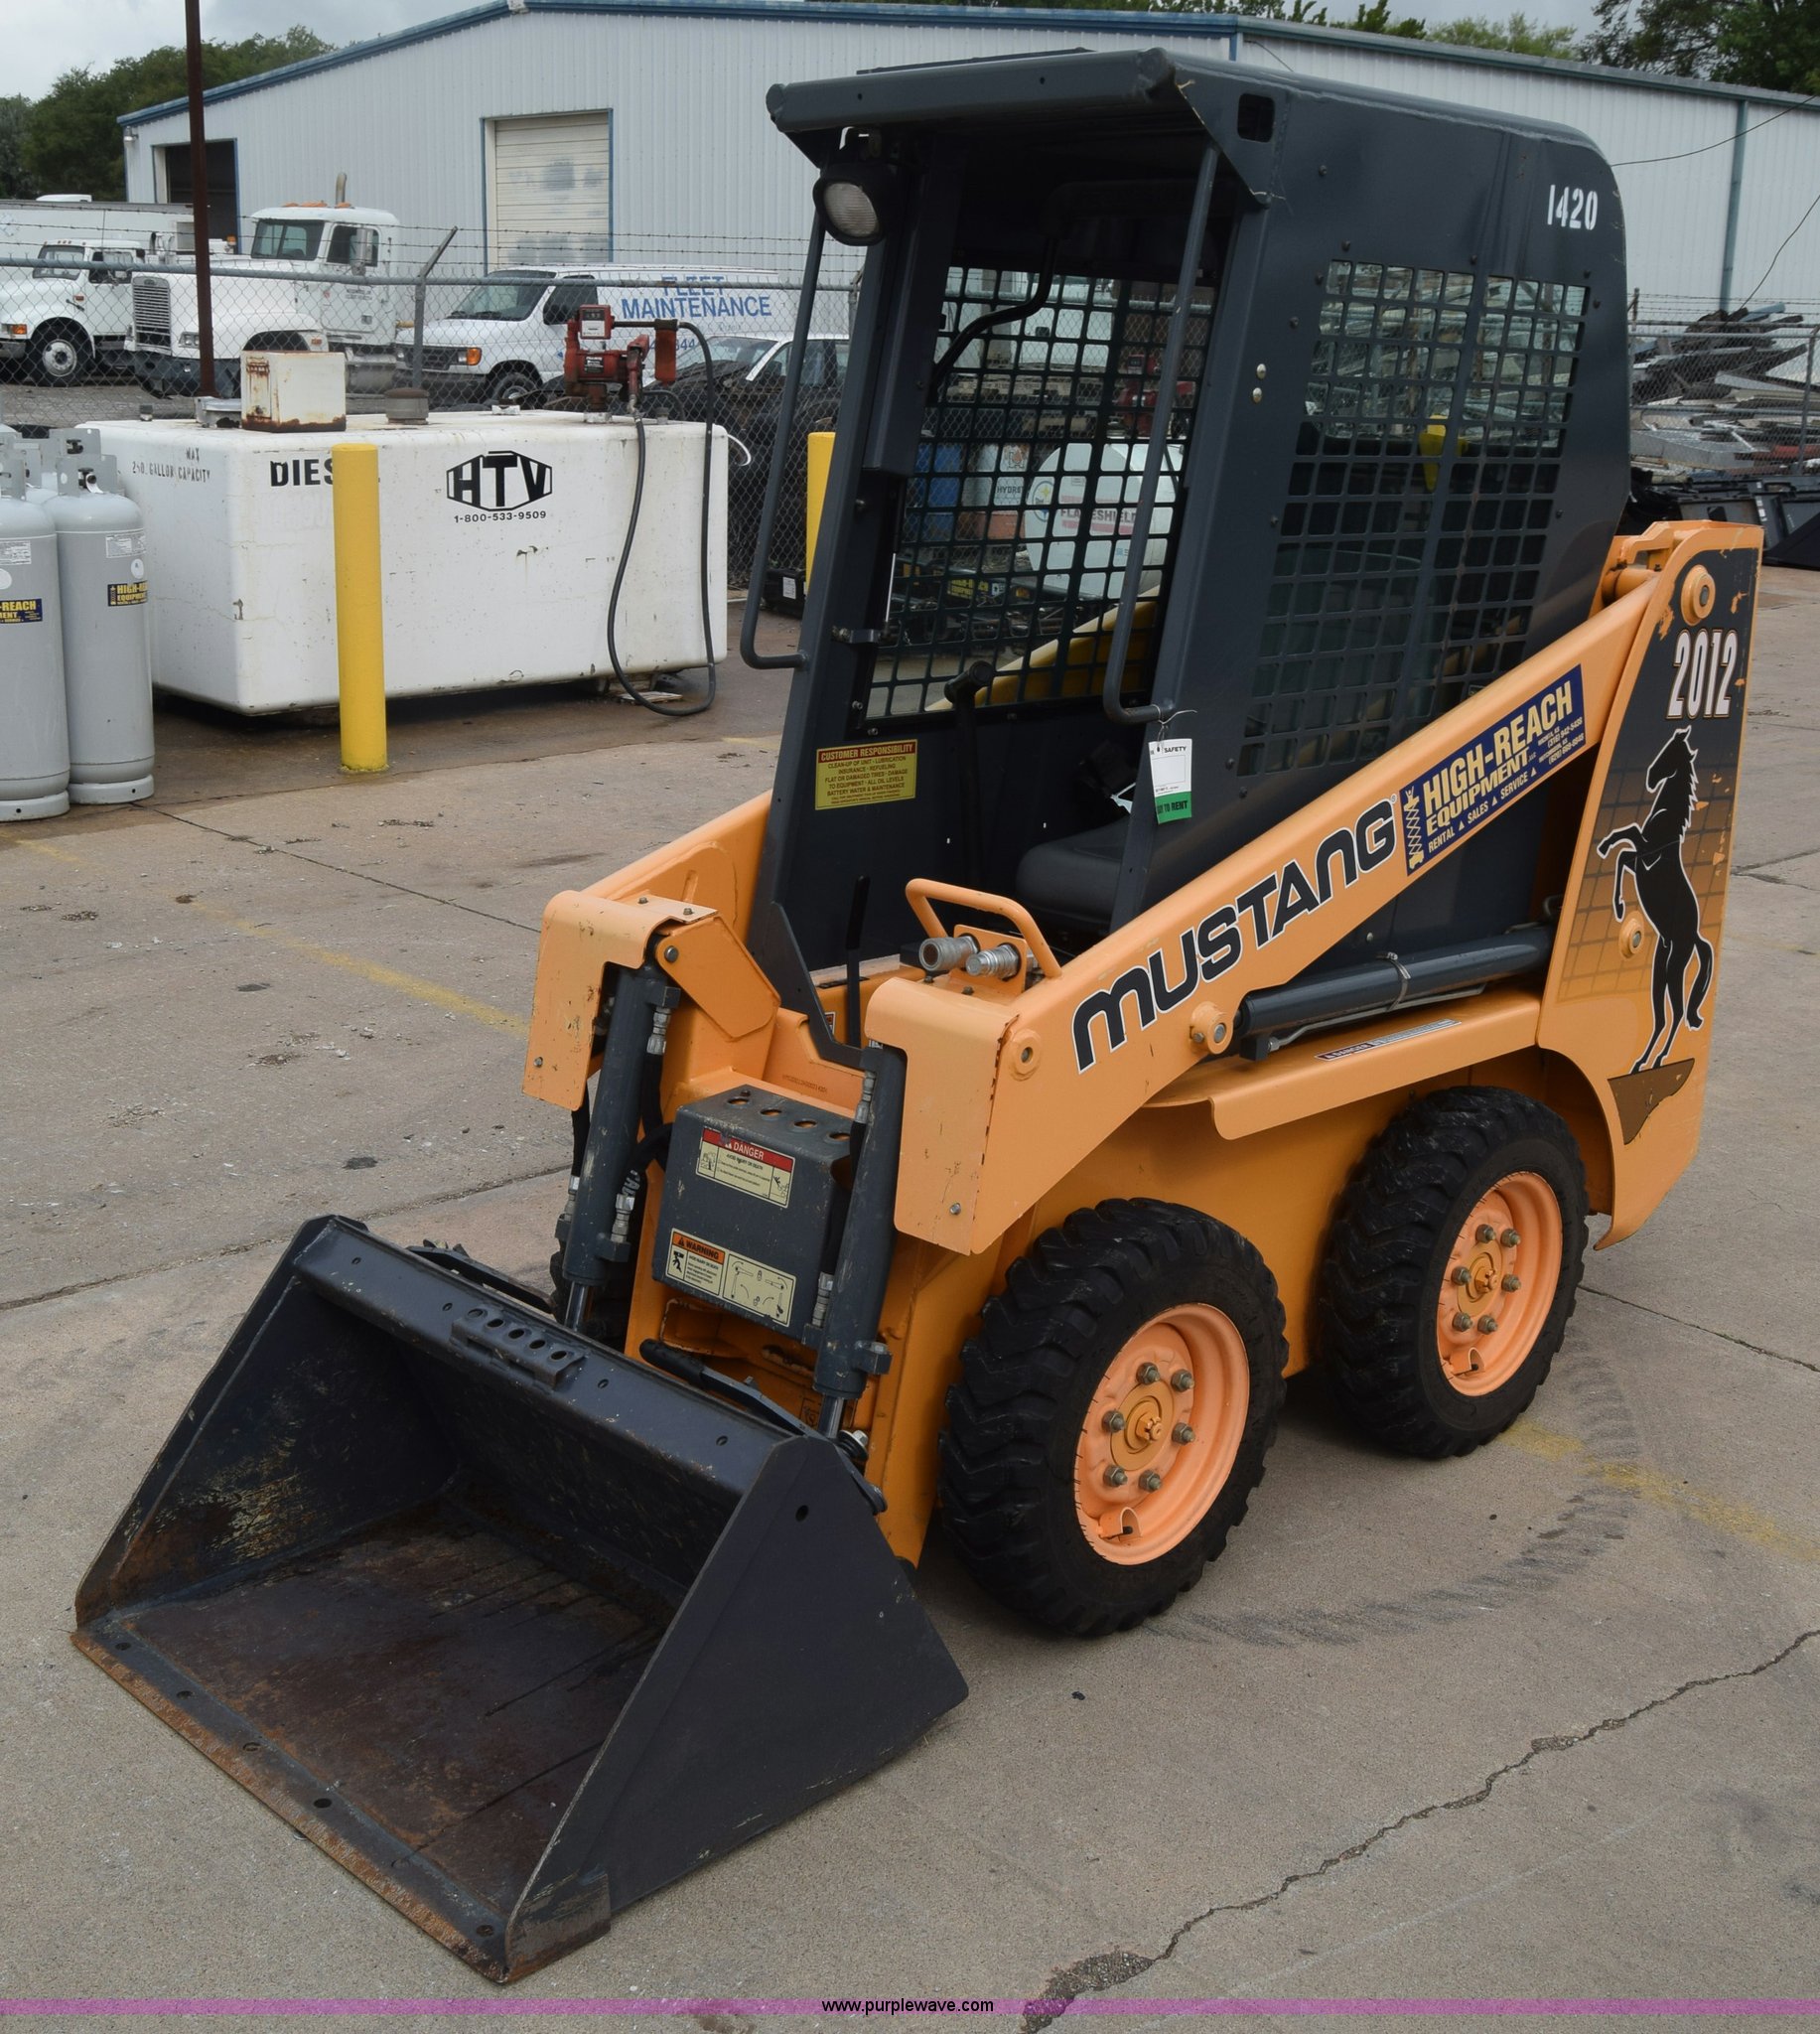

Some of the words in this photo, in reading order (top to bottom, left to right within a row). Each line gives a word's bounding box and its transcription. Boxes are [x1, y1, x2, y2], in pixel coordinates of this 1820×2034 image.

[1547, 184, 1599, 230] 1420
[661, 275, 725, 296] FLEET
[621, 296, 772, 319] MAINTENANCE
[452, 453, 548, 508] HTV
[453, 510, 547, 523] 1-800-533-9509
[1059, 508, 1138, 523] FLAESHIEL
[1665, 627, 1739, 720] 2012
[821, 749, 859, 761] CUSTOMER
[860, 744, 912, 757] RESPONSIBILITY
[1422, 679, 1574, 817] HIGH-REACH
[1426, 745, 1530, 837] EQUIPMENT
[1172, 800, 1188, 810] RENT
[1428, 823, 1456, 854] RENTAL
[1467, 799, 1489, 825] SALES
[1500, 771, 1529, 800] SERVICE
[1071, 798, 1397, 1075] MUSTANG
[733, 1141, 765, 1160] DANGER
[686, 1239, 719, 1260] WARNING
